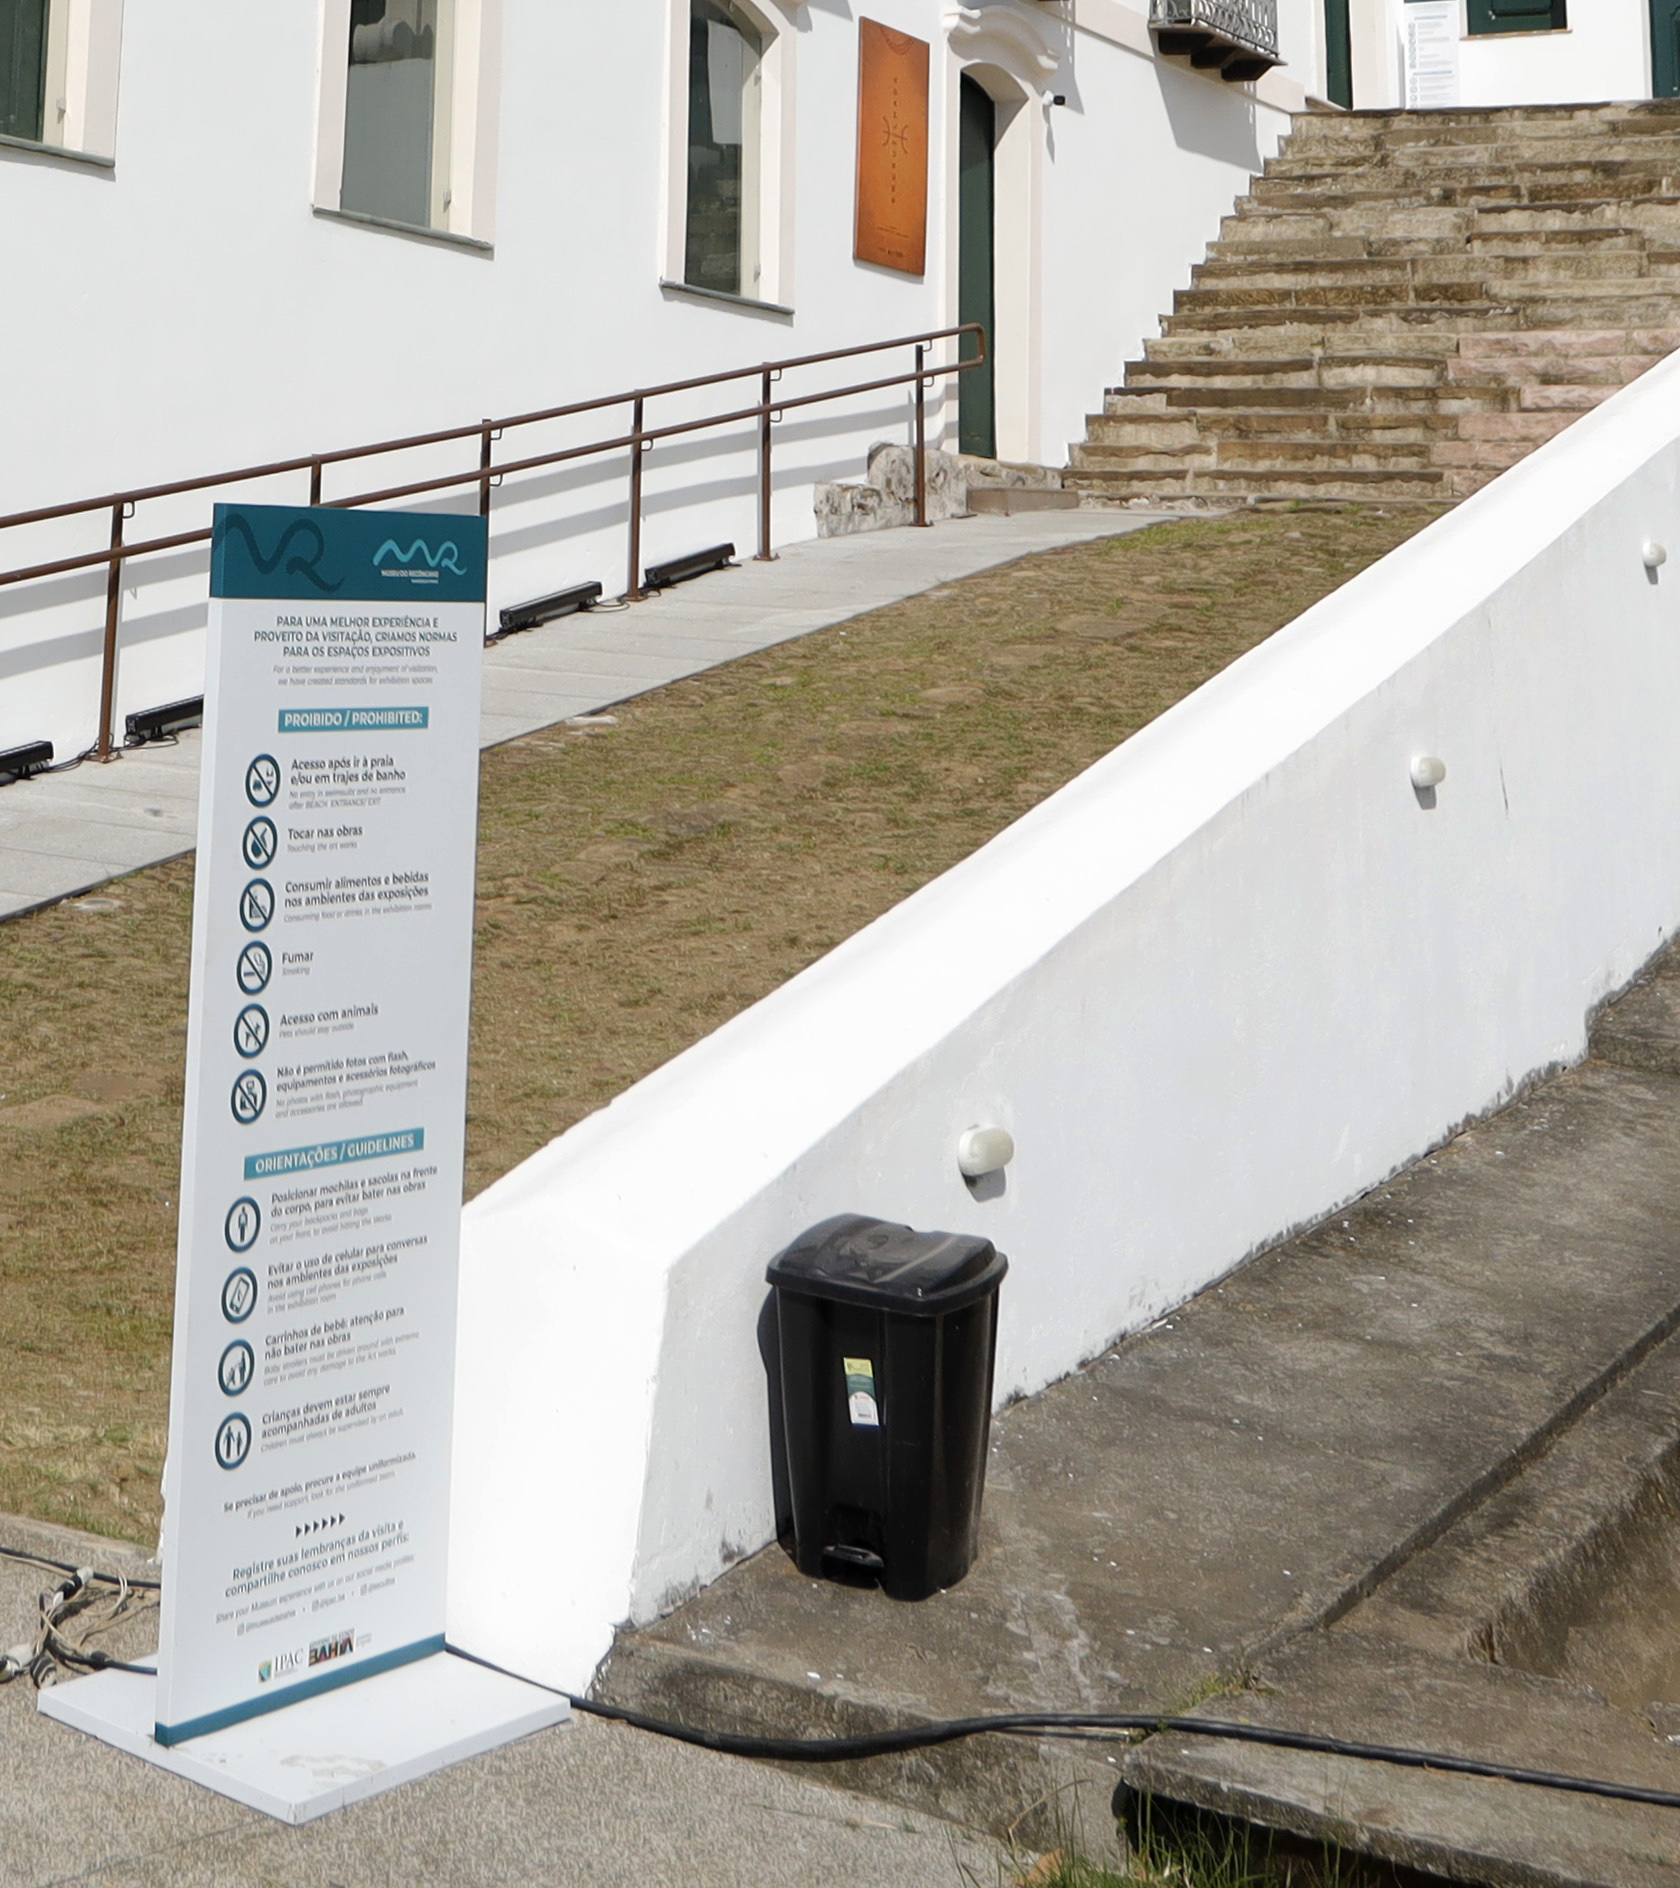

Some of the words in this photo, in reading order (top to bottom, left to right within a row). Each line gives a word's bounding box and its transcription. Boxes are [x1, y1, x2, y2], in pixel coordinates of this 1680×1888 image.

[277, 616, 303, 627] PARA
[306, 616, 328, 627] UMA
[330, 617, 370, 628] MELHOR
[373, 615, 430, 628] EXPERIÊNCIA
[433, 618, 438, 628] E
[254, 631, 303, 642] PROVEITO
[306, 632, 319, 642] DA
[322, 629, 373, 645] VISITAÇÃO,
[375, 632, 416, 642] CRIAMOS
[419, 632, 457, 642] NORMAS
[283, 646, 309, 657] PARA
[312, 646, 324, 657] OS
[328, 646, 369, 659] ESPAÇOS
[373, 646, 430, 656] EXPOSITIVOS
[284, 712, 341, 727] PROIBIDO
[344, 710, 350, 727] /
[352, 710, 423, 725] PROHIBITED:
[291, 759, 325, 770] Acesso
[328, 758, 350, 771] após
[353, 755, 360, 767] ir
[362, 755, 368, 767] à
[371, 754, 394, 769] praia
[290, 773, 312, 786] e/ou
[315, 775, 330, 784] em
[332, 771, 359, 785] trajes
[362, 771, 373, 781] de
[377, 769, 405, 781] banho
[288, 828, 314, 839] Tocar
[317, 827, 334, 837] nas
[337, 825, 363, 836] obras
[285, 877, 332, 893] Consumir
[335, 874, 382, 889] alimentos
[385, 876, 390, 885] e
[392, 871, 428, 884] bebidas
[284, 897, 302, 908] nos
[305, 892, 356, 906] ambientes
[359, 890, 375, 901] das
[378, 886, 429, 902] exposições
[282, 951, 314, 964] Fumar
[280, 1013, 315, 1027] Acesso
[317, 1012, 339, 1023] com
[341, 1002, 378, 1019] animais
[276, 1075, 337, 1092] equipamentos
[346, 1068, 387, 1081] acessórios
[389, 1061, 436, 1077] fotográficos
[277, 1066, 294, 1078] Não
[297, 1064, 301, 1076] é
[303, 1060, 344, 1076] permitido
[346, 1058, 366, 1068] fotos
[368, 1054, 386, 1064] com
[255, 1147, 338, 1173] ORIENTAÇÕES
[347, 1134, 414, 1158] GUIDELINES
[272, 1189, 317, 1204] Posicionar
[320, 1180, 359, 1195] mochilas
[368, 1172, 398, 1186] sacolas
[401, 1172, 411, 1181] na
[413, 1166, 437, 1179] frente
[271, 1207, 283, 1218] do
[285, 1204, 311, 1216] corpo,
[314, 1199, 333, 1212] para
[336, 1194, 360, 1206] evitar
[362, 1189, 384, 1201] bater
[386, 1185, 401, 1195] nas
[403, 1180, 426, 1193] obras
[268, 1262, 296, 1276] Evitar
[296, 1262, 302, 1270] o
[304, 1258, 320, 1268] uso
[322, 1253, 333, 1265] de
[335, 1247, 364, 1262] celular
[366, 1244, 385, 1257] para
[386, 1235, 428, 1251] conversas
[267, 1279, 284, 1290] nos
[286, 1268, 332, 1286] ambientes
[335, 1263, 349, 1275] das
[352, 1253, 398, 1271] exposições
[265, 1329, 309, 1346] Carrinhos
[311, 1325, 322, 1336] de
[324, 1320, 348, 1333] bebê:
[350, 1312, 384, 1327] atenção
[386, 1307, 404, 1320] para
[265, 1348, 282, 1360] não
[284, 1342, 307, 1356] bater
[309, 1339, 325, 1350] nas
[327, 1332, 351, 1346] obras
[262, 1407, 301, 1425] Crianças
[303, 1400, 333, 1414] devem
[335, 1393, 356, 1406] estar
[359, 1384, 390, 1401] sempre
[262, 1413, 330, 1439] acompanhadas
[332, 1410, 343, 1420] de
[345, 1401, 377, 1417] adultos
[224, 1501, 234, 1512] Se
[235, 1492, 267, 1511] precisar
[269, 1488, 279, 1500] de
[280, 1483, 303, 1498] apoio,
[305, 1476, 334, 1492] procure
[342, 1465, 367, 1482] equipe
[369, 1452, 416, 1471] uniformizada
[233, 1559, 275, 1581] Registre
[277, 1553, 299, 1567] suas
[300, 1536, 356, 1559] lembranças
[358, 1530, 370, 1543] da
[372, 1522, 396, 1539] visita
[398, 1520, 404, 1530] e
[225, 1571, 285, 1598] compartilhe
[288, 1559, 328, 1578] conosco
[330, 1553, 346, 1566] em
[348, 1545, 379, 1559] nossos
[381, 1533, 410, 1551] perfis:
[275, 1650, 303, 1672] IPAC
